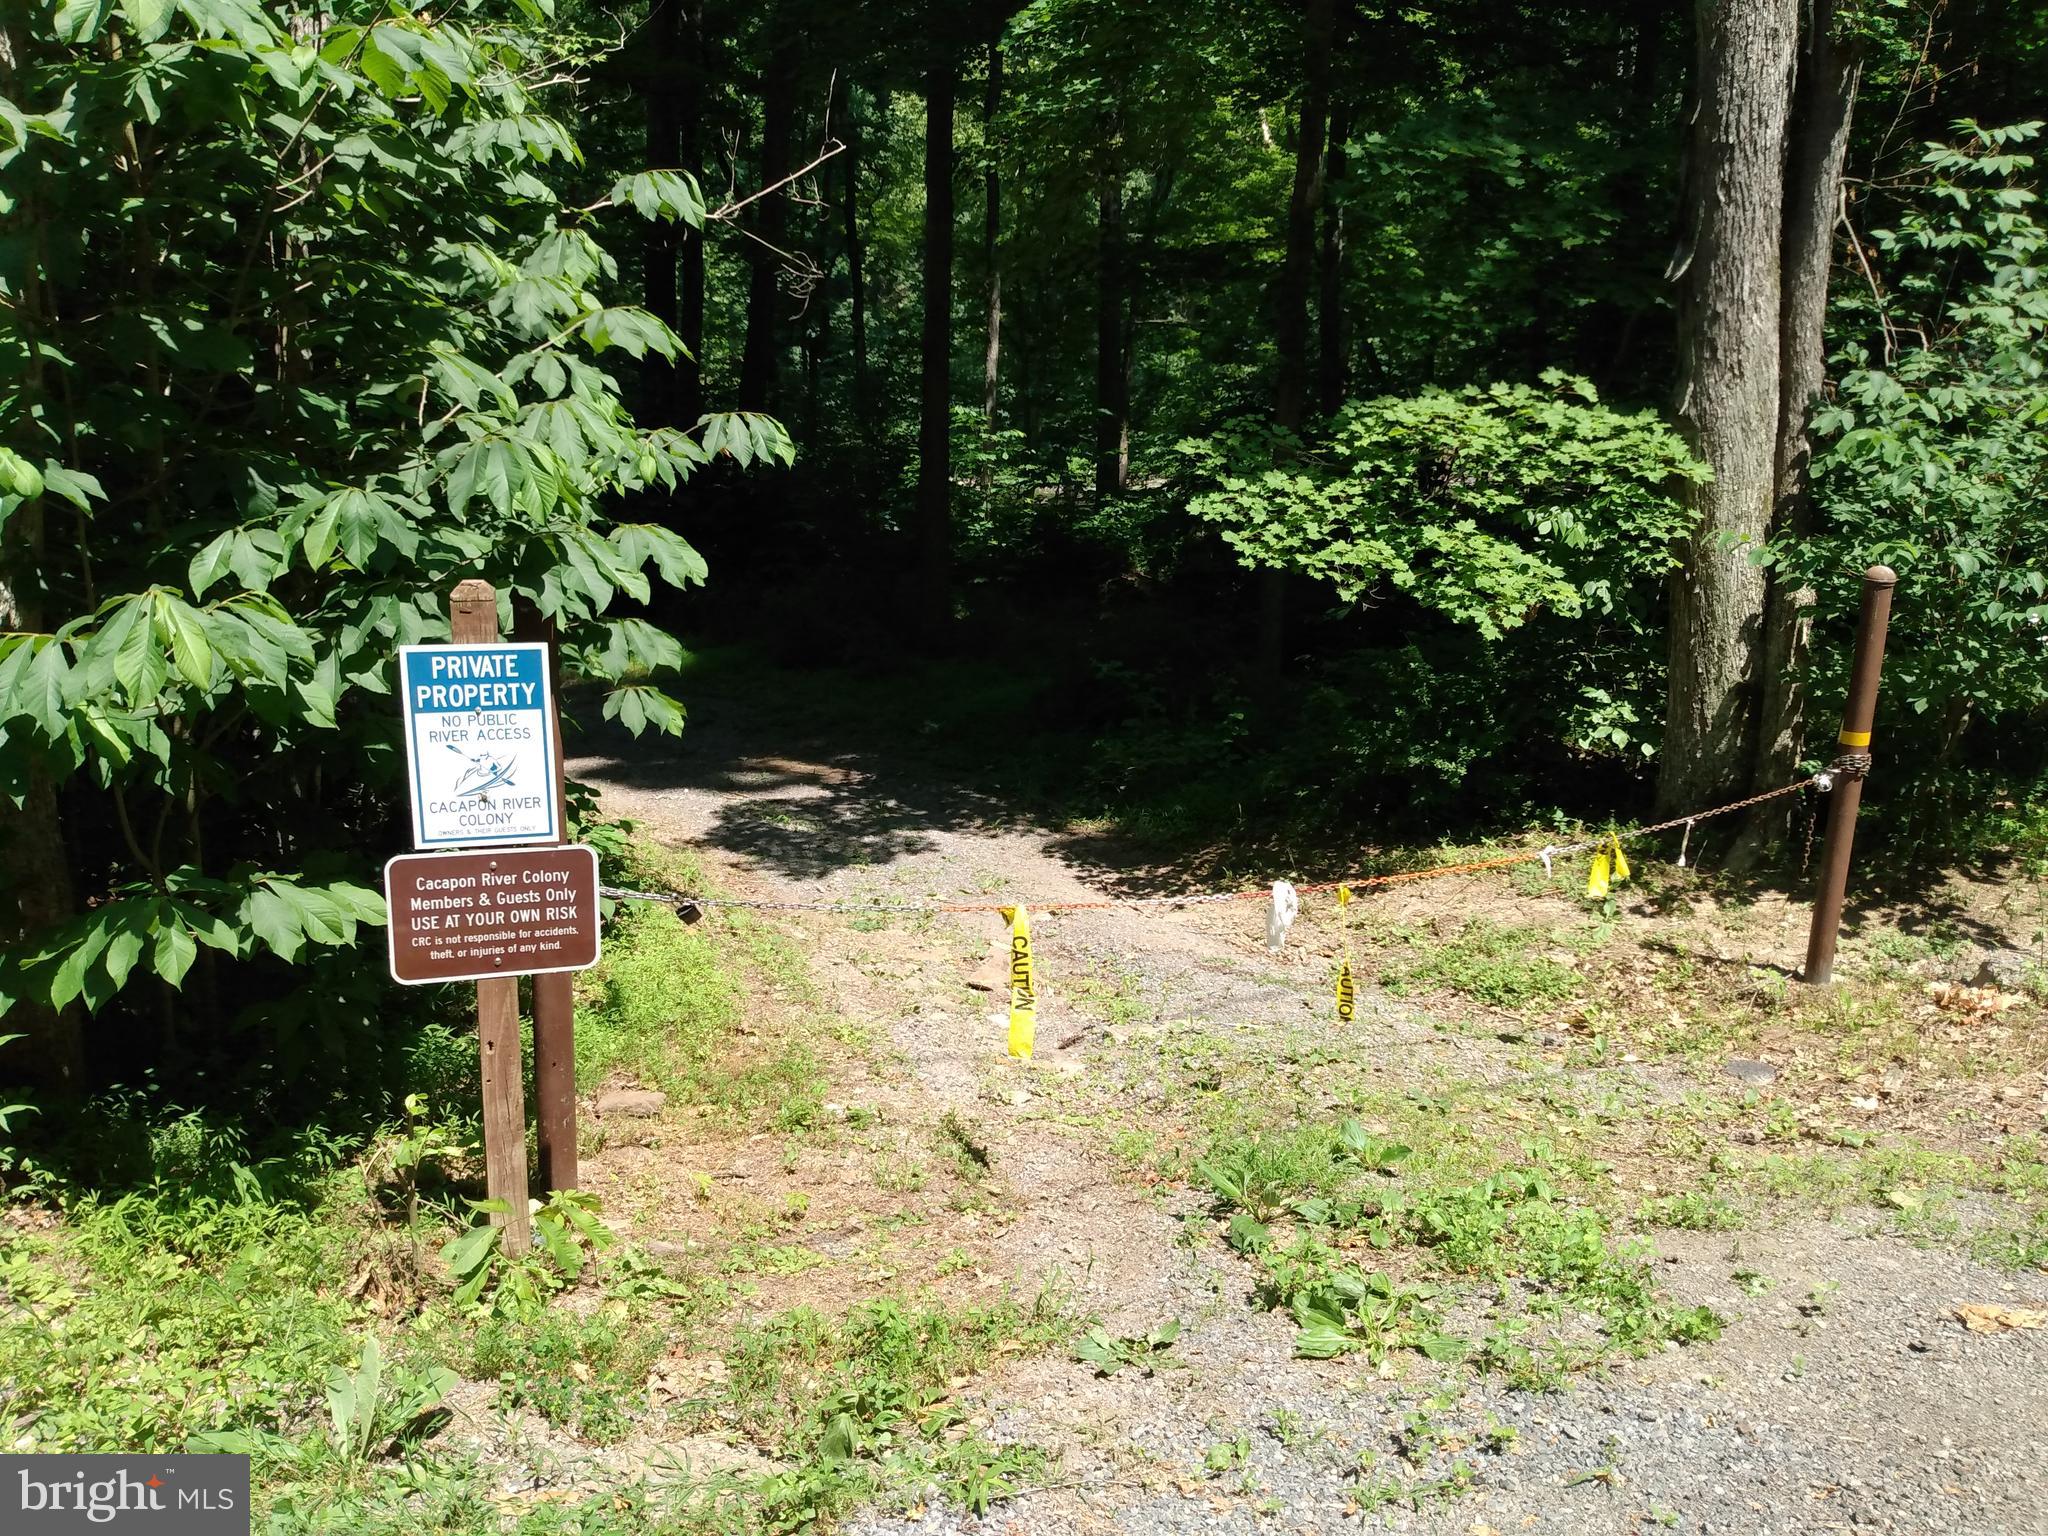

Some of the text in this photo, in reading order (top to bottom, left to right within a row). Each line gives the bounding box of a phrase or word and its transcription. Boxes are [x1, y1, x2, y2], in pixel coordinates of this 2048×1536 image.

[432, 655, 519, 679] PRIVATE
[417, 682, 535, 708] PROPERTY
[442, 713, 517, 727] NO PUBLIC
[429, 728, 531, 742] RIVER ACCESS
[429, 797, 541, 813] CACAPON RIVER
[459, 813, 513, 826] COLONY
[416, 870, 570, 891] Cacapon River Colony
[411, 887, 576, 911] Members & Guests Only
[412, 906, 577, 930] USE AT YOUR OWN RISK
[412, 936, 431, 947] CRC
[435, 935, 442, 945] is
[446, 934, 461, 944] not
[464, 930, 515, 943] responsible
[519, 929, 532, 938] for
[457, 949, 467, 957] or
[470, 943, 505, 957] injuries
[508, 944, 517, 953] of
[520, 942, 536, 954] any
[540, 940, 562, 950] kind.
